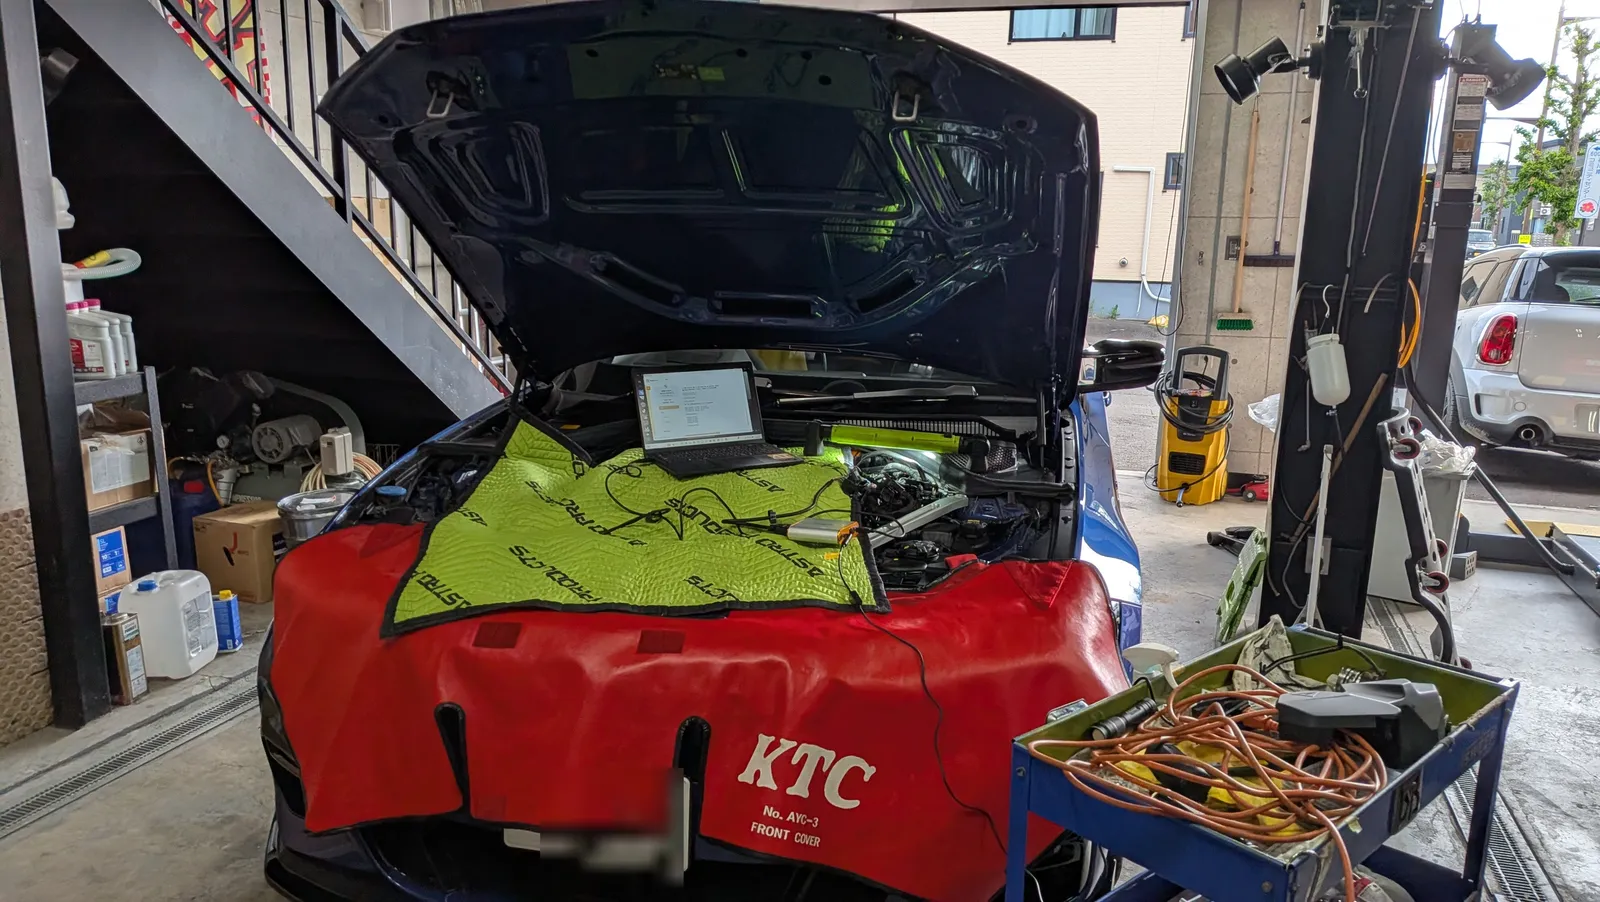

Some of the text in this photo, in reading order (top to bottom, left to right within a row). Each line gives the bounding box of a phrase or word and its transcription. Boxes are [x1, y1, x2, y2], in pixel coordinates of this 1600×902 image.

[755, 538, 824, 577] ASTRO
[737, 733, 877, 809] KTC
[763, 805, 819, 828] No. AYC-3
[750, 821, 821, 847] FRONT COVER
